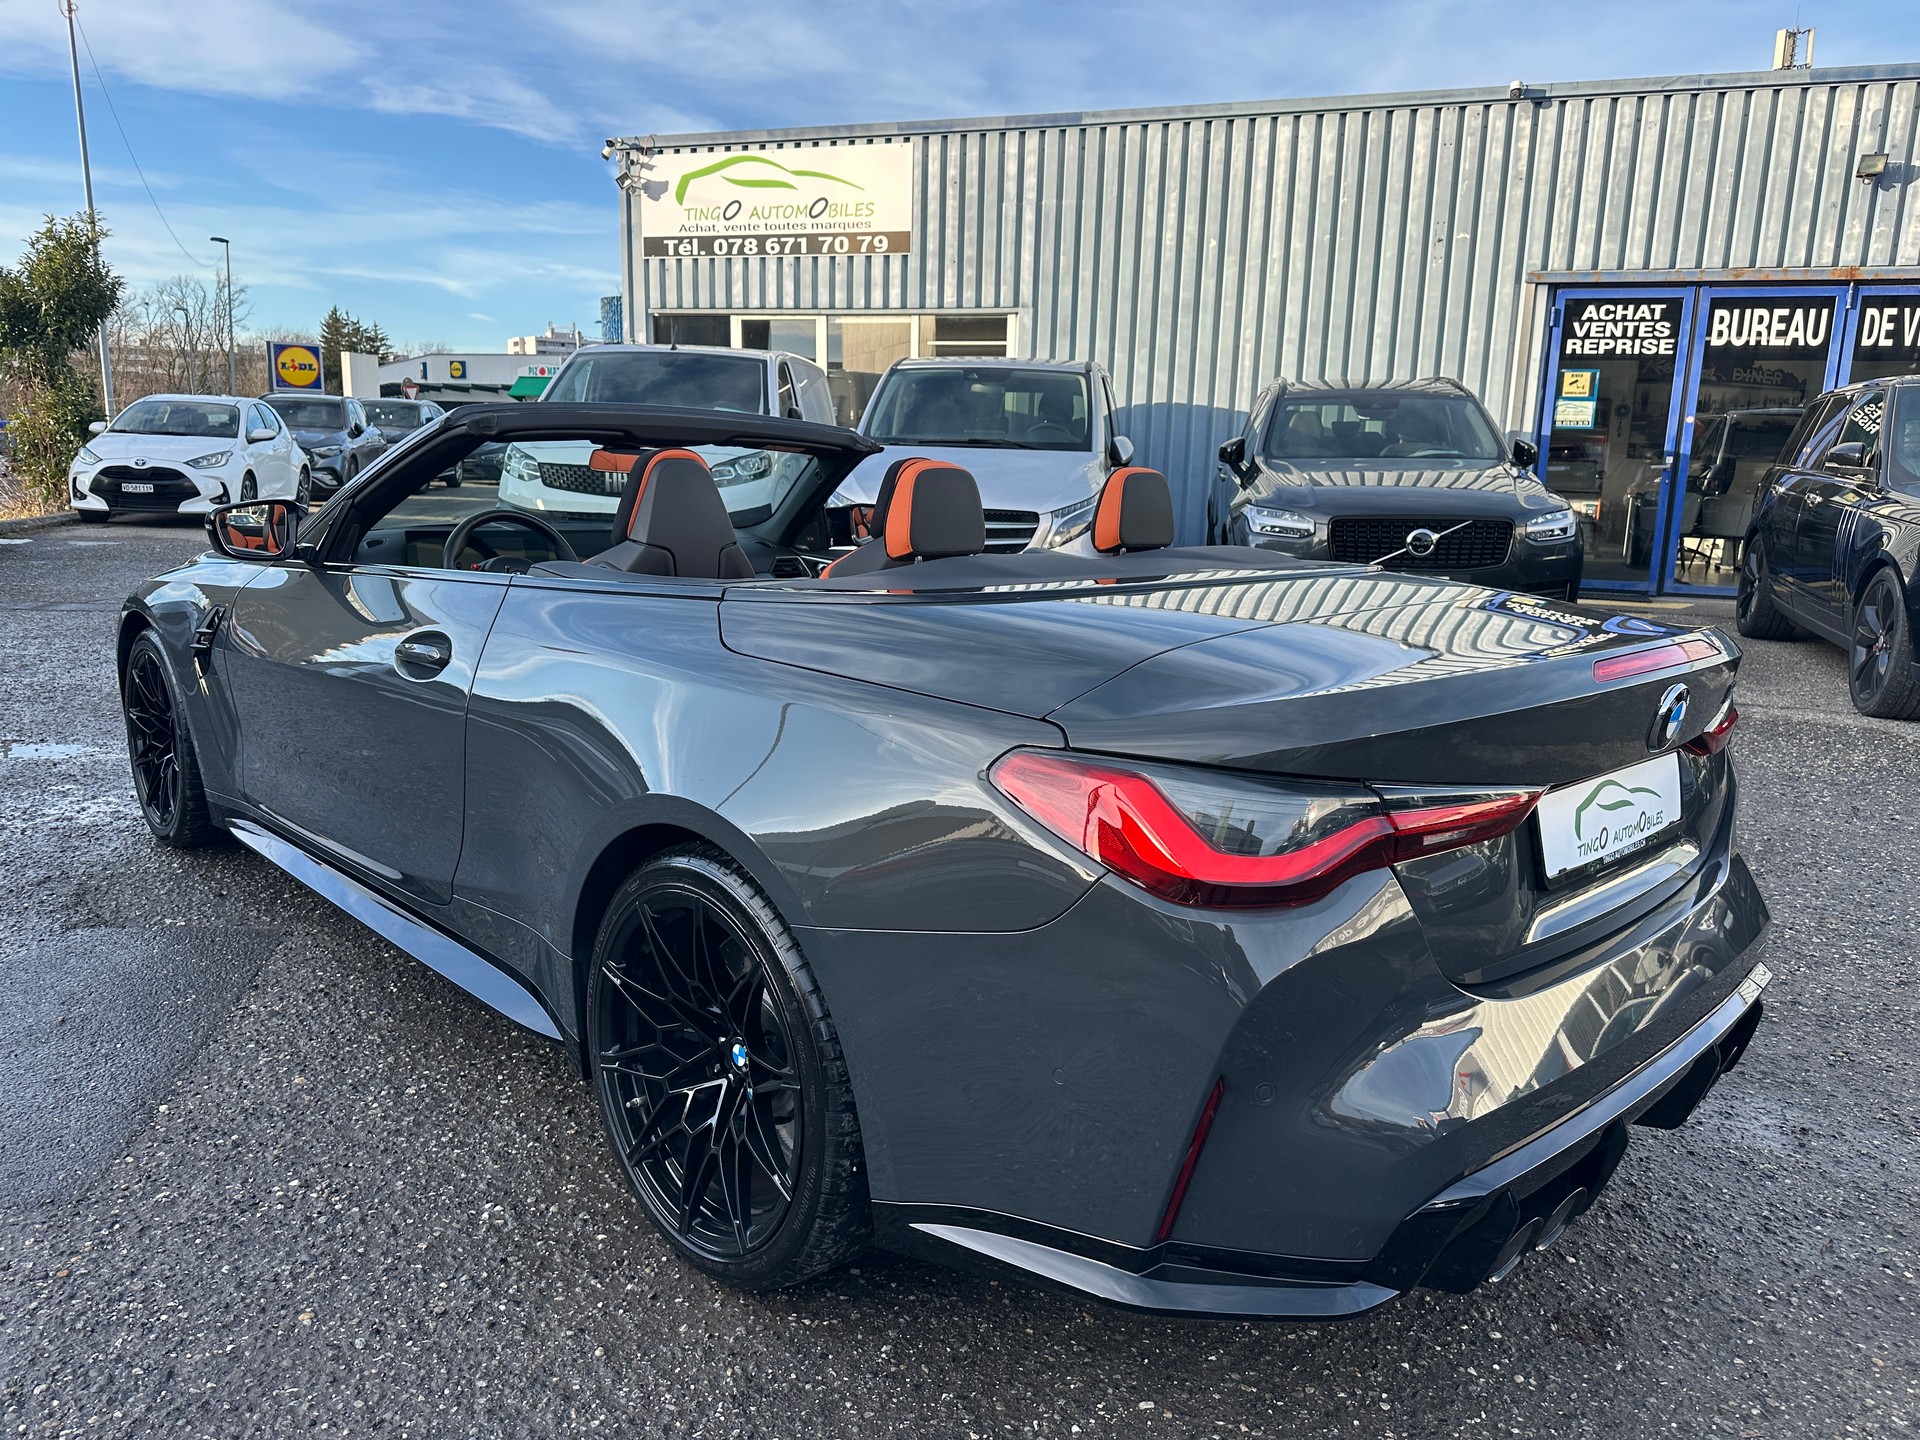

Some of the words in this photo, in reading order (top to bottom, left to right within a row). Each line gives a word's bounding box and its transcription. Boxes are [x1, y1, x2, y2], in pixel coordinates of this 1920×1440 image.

[684, 200, 742, 222] TINGO
[748, 197, 875, 221] AUTOMOBILES
[679, 223, 720, 234] Achat,
[724, 223, 760, 232] vente
[764, 221, 807, 232] toutes
[811, 220, 872, 231] marques
[663, 239, 706, 256] Tél.
[713, 238, 759, 255] 078
[765, 237, 807, 254] 671
[818, 236, 850, 253] 70
[856, 235, 889, 253] 79
[1581, 304, 1667, 320] ACHAT
[1573, 321, 1671, 338] VENTES
[1710, 308, 1829, 347] BUREAU
[1861, 307, 1898, 347] DE
[1565, 338, 1675, 355] REPRISE
[1577, 827, 1609, 858] TINGO
[1613, 810, 1664, 844] AUTOMOBILES
